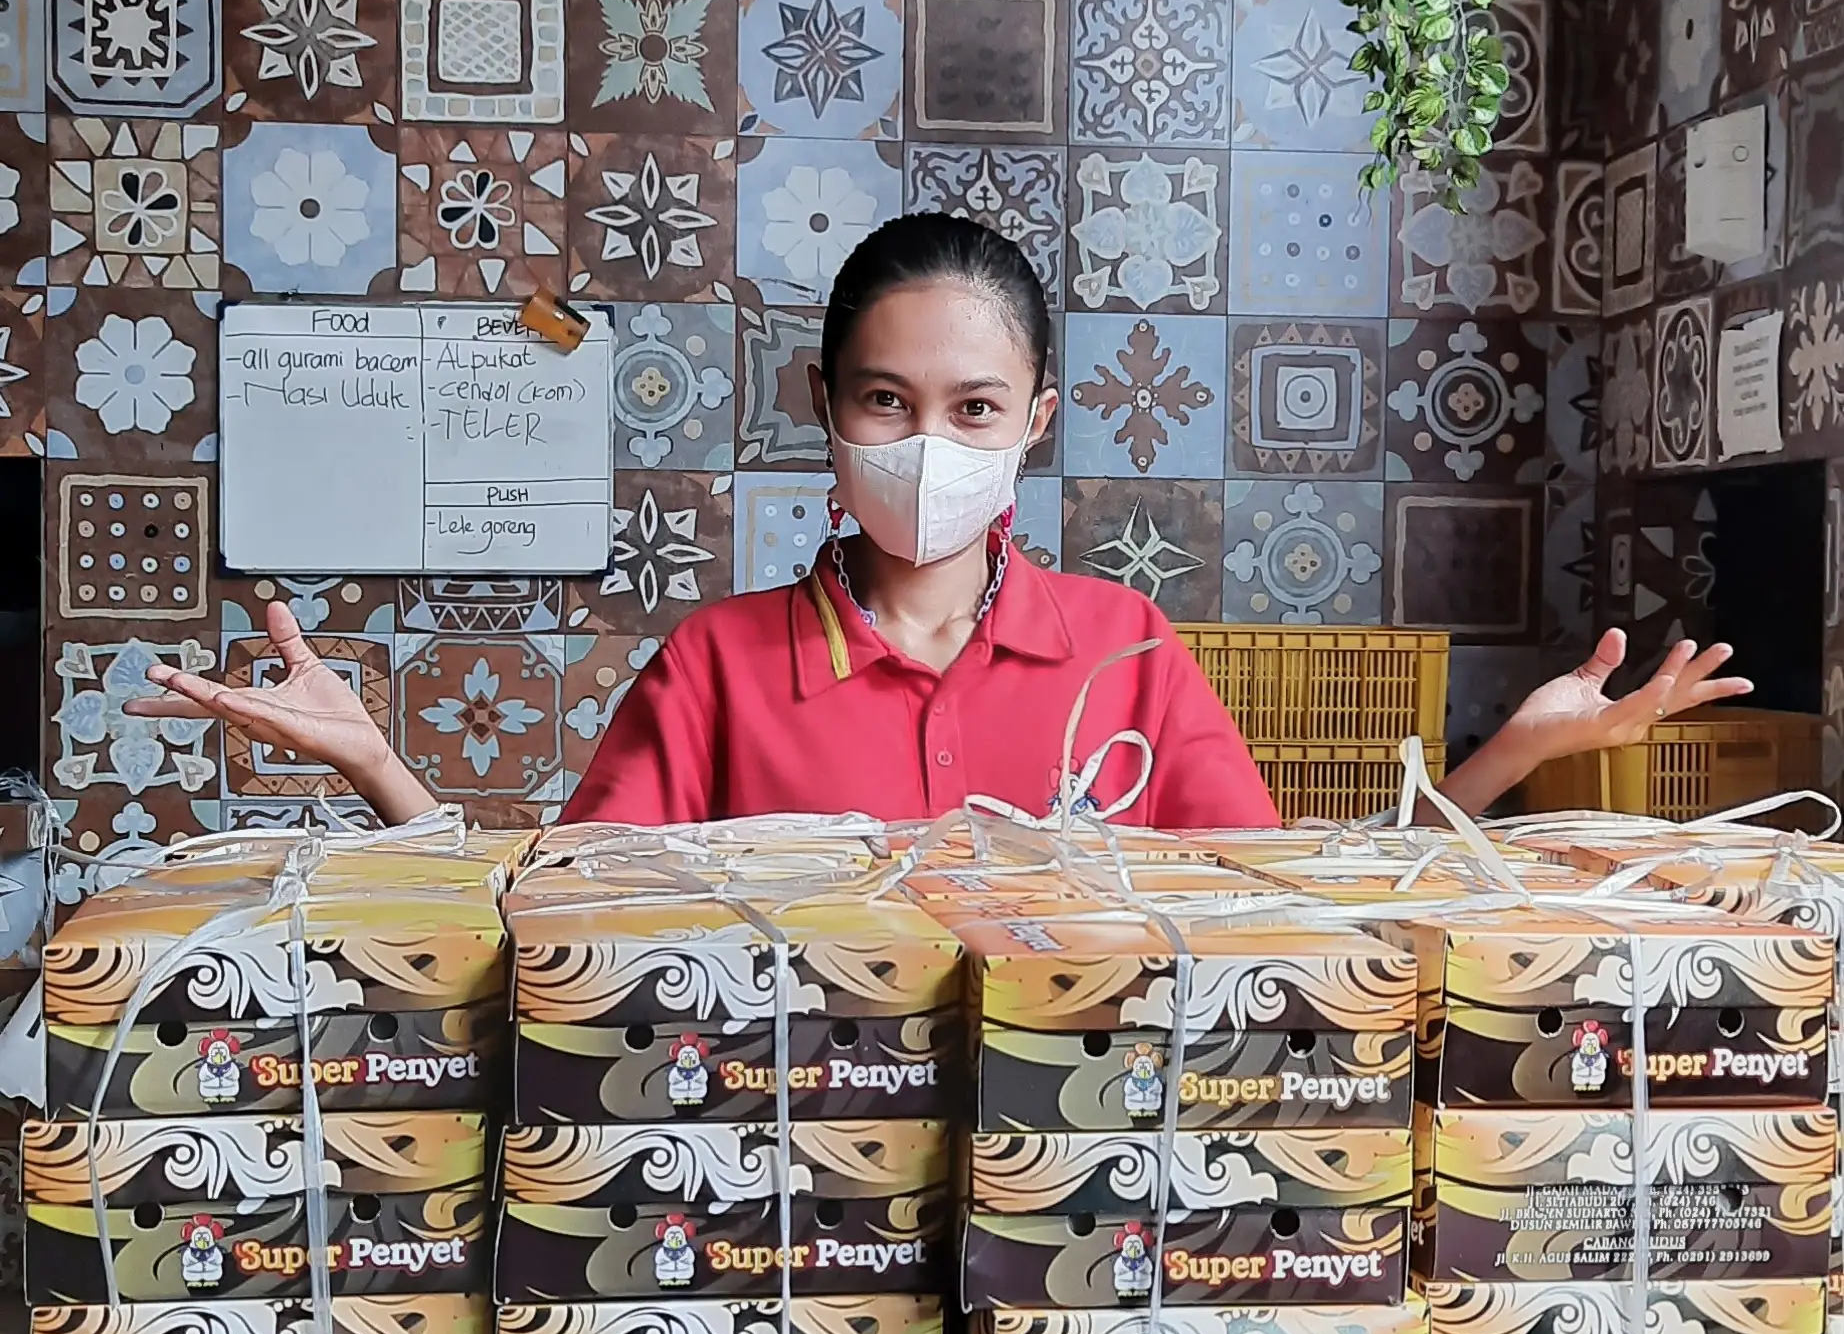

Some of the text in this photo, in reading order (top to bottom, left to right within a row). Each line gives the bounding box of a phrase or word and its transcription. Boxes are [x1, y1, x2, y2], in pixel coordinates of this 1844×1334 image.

[312, 309, 369, 333] Food
[277, 351, 344, 379] gurami
[341, 377, 410, 410] Uduk
[486, 486, 529, 505] PUSH
[462, 519, 537, 553] goreng
[364, 1052, 480, 1088] Penyet
[829, 1059, 938, 1095] Penyet
[1711, 1048, 1809, 1084] Penyet
[1179, 1071, 1392, 1107] Super Penyet
[349, 1235, 464, 1272] Penyet
[815, 1237, 927, 1273] Penyet
[1649, 1236, 1686, 1249] UDUS
[1165, 1249, 1382, 1286] Super Penyet
